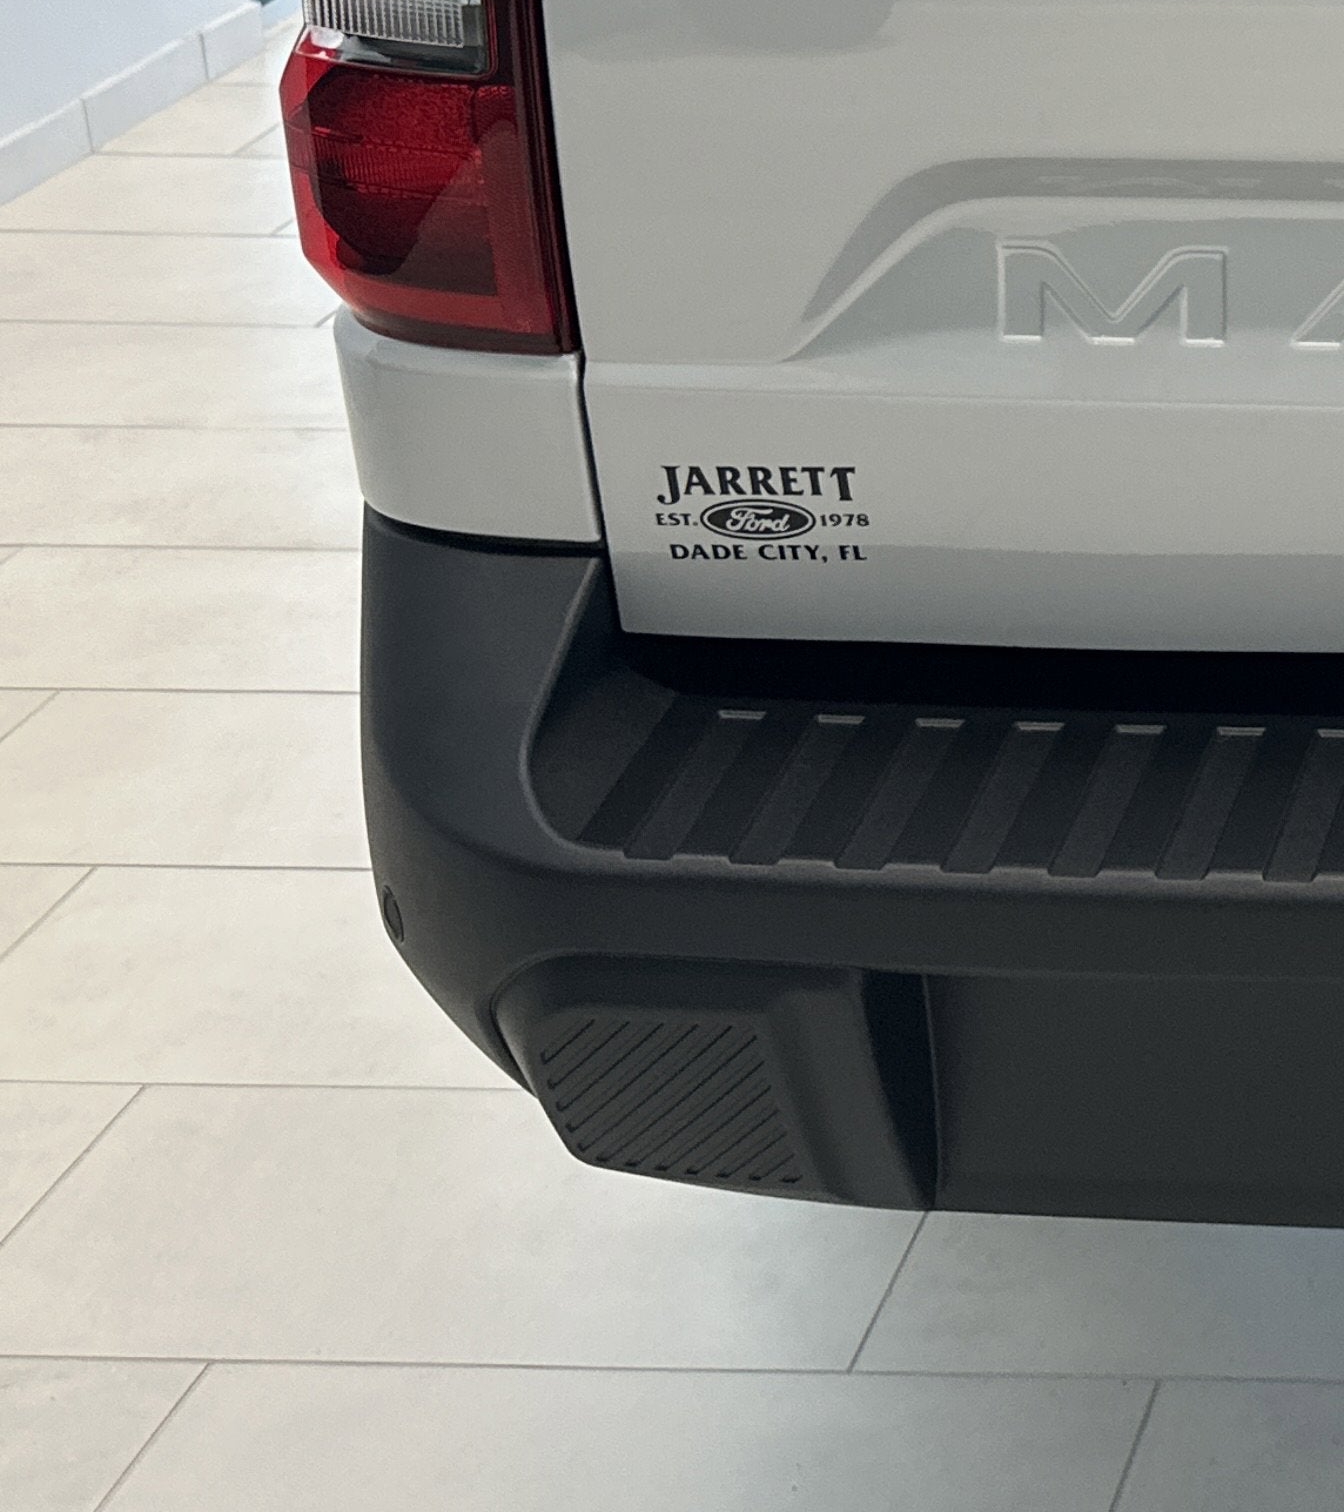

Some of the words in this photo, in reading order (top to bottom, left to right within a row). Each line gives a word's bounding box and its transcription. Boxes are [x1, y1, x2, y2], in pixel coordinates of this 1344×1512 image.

[657, 465, 856, 505] JARRETT
[656, 513, 698, 526] EST.
[725, 507, 792, 533] Ford
[820, 513, 869, 526] 1978
[670, 544, 748, 560] DADE
[758, 544, 828, 563] CITY,
[839, 545, 867, 561] FL
